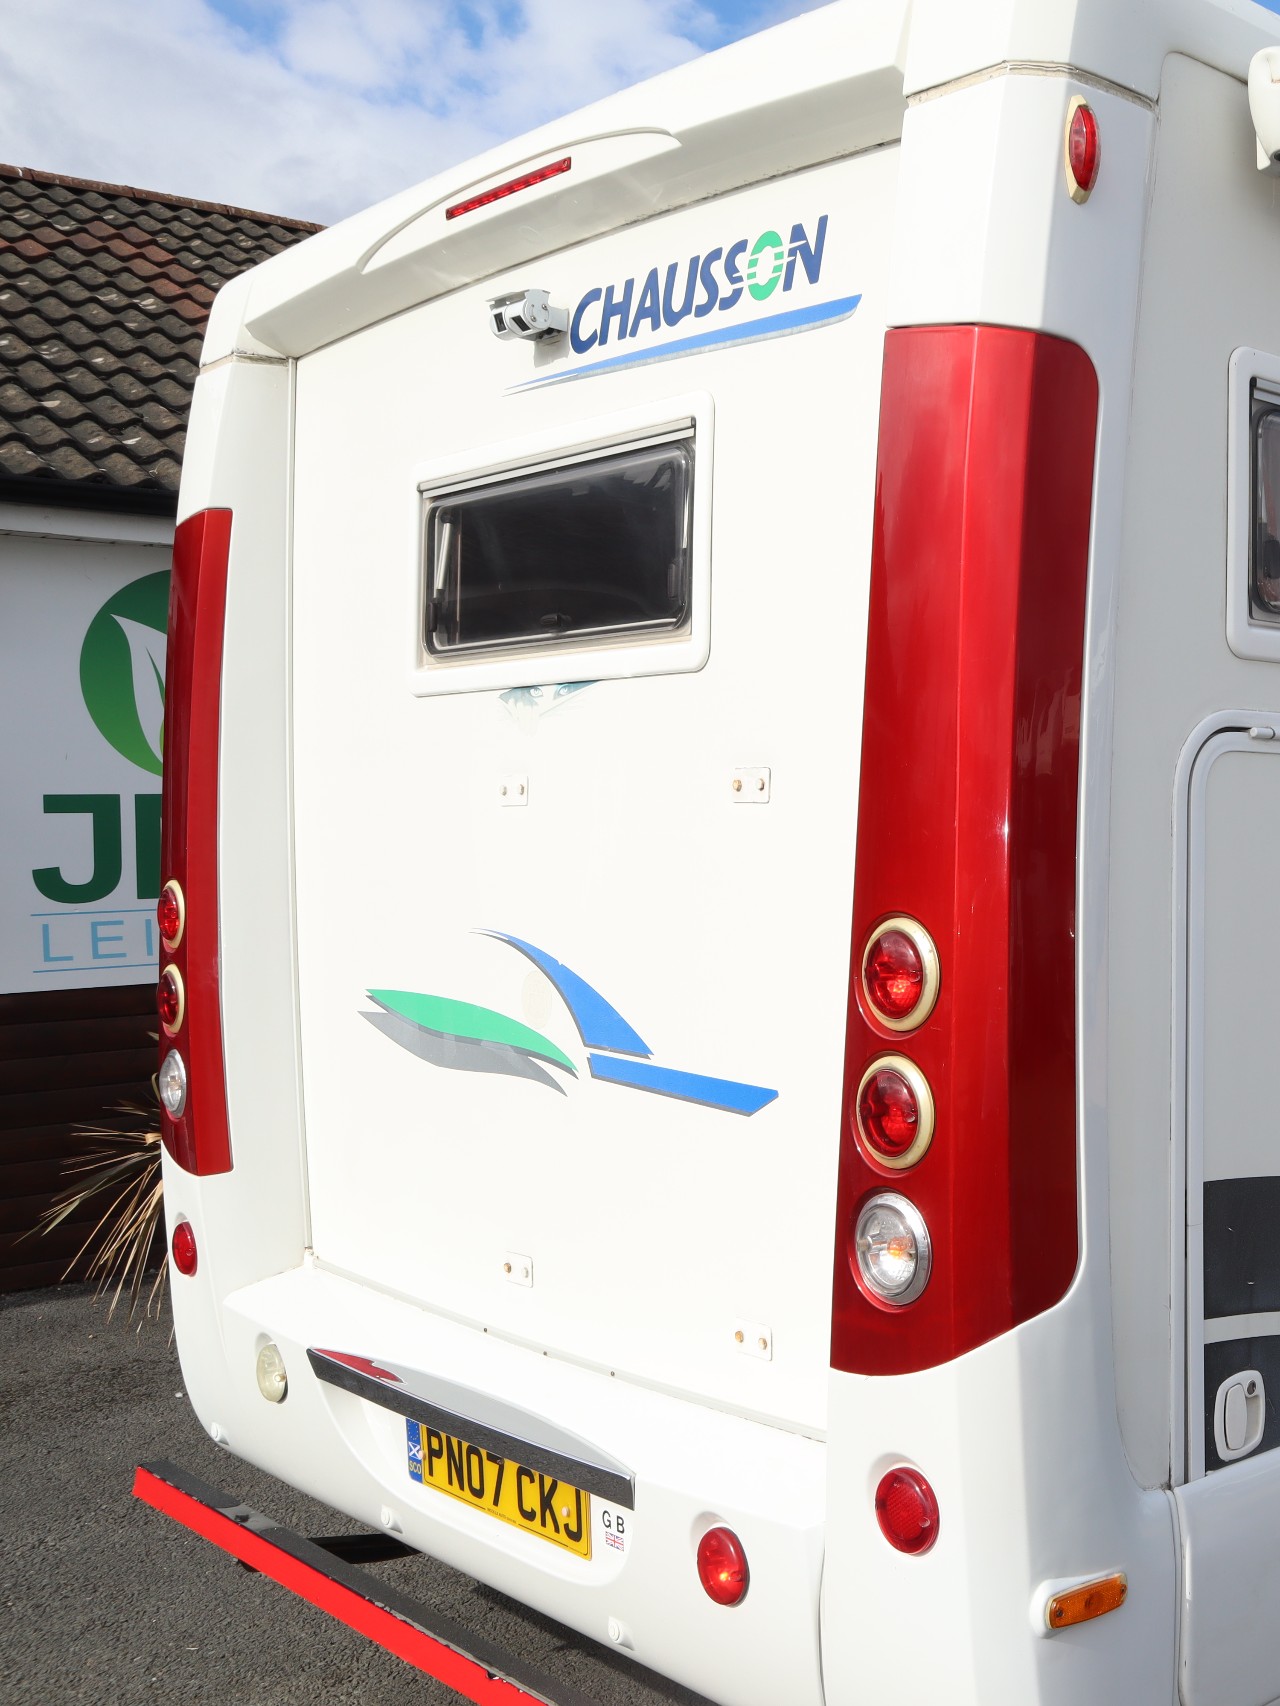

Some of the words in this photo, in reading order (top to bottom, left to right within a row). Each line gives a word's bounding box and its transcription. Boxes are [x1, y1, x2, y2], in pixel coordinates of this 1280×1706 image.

[569, 214, 829, 355] CHAUSSON
[409, 1460, 422, 1475] SCO
[426, 1426, 505, 1508] PN07
[515, 1466, 583, 1543] CKJ
